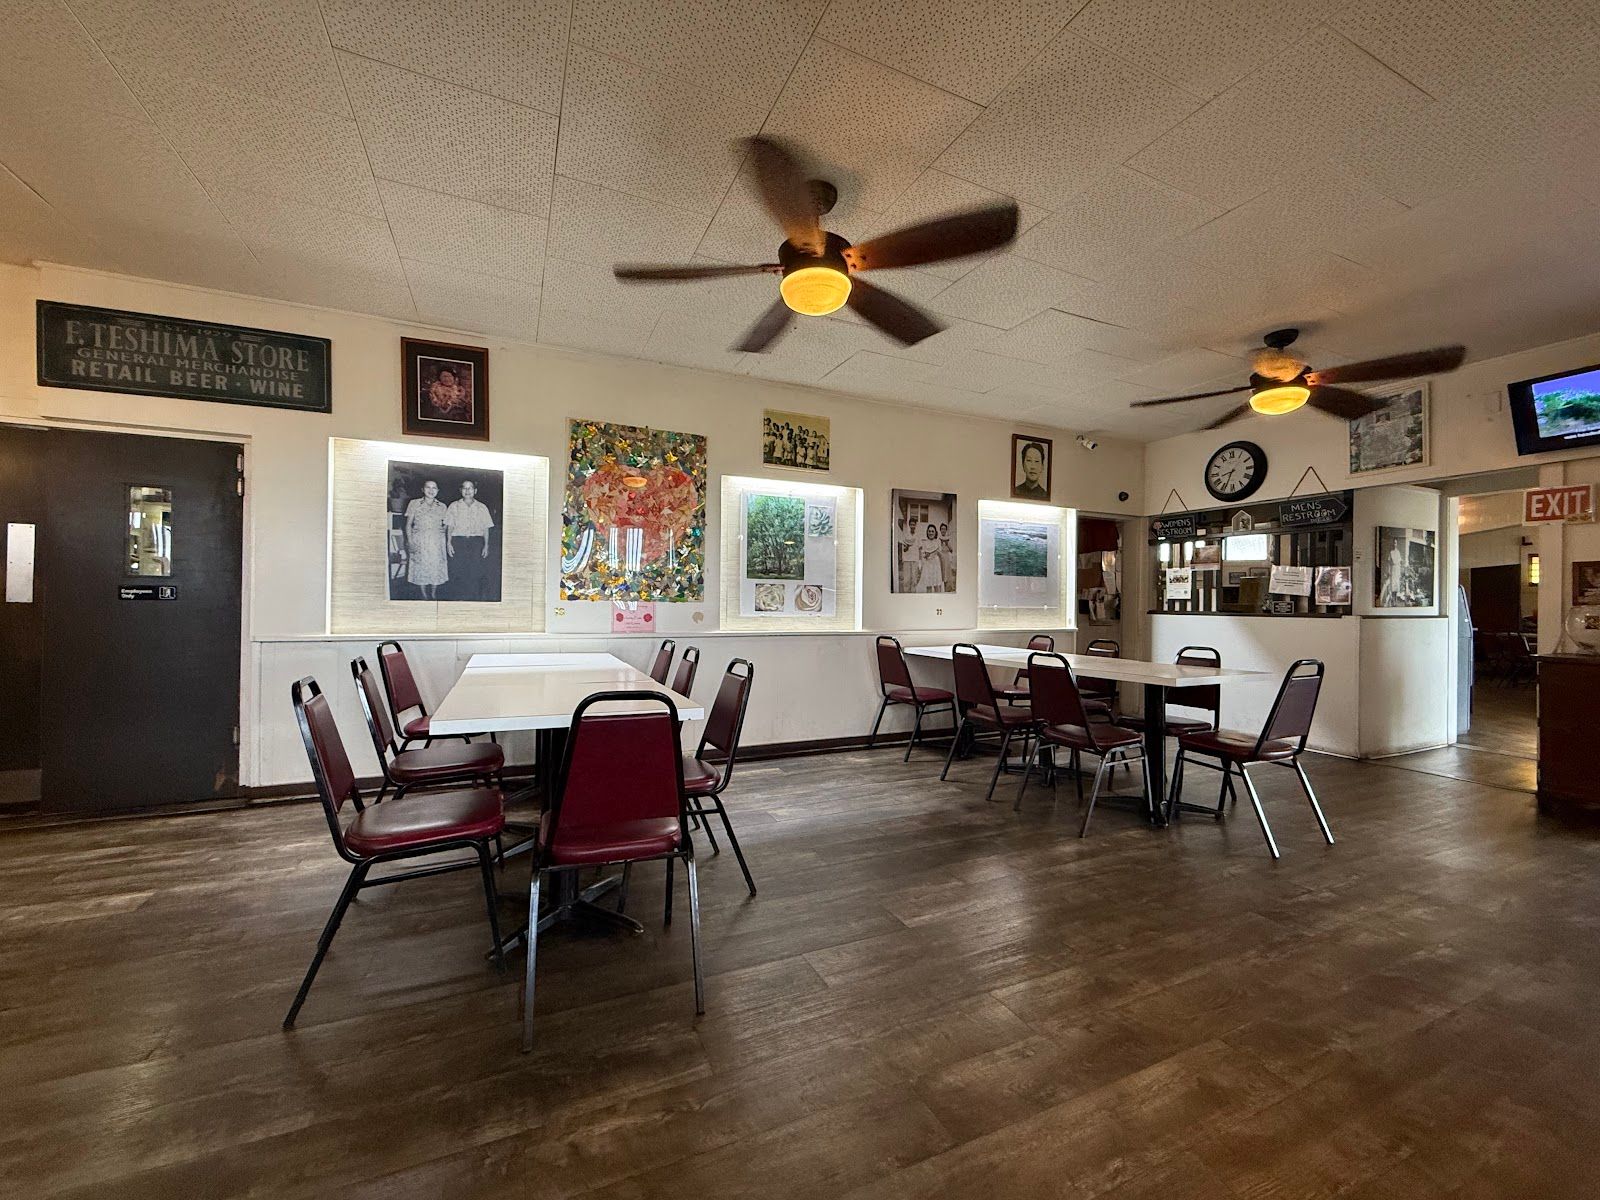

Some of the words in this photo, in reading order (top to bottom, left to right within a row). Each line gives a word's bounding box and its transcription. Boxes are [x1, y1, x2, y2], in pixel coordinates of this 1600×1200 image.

[92, 322, 219, 363] TESHIMA
[231, 340, 310, 373] STORE
[71, 358, 157, 385] RETAIL
[169, 369, 229, 392] BEER
[249, 378, 304, 399] WINE
[76, 347, 169, 368] GENERAL
[175, 358, 300, 382] MERCHANDISE
[1282, 508, 1337, 523] RESTROOM
[1290, 500, 1322, 512] MENS
[1531, 490, 1586, 517] EXIT
